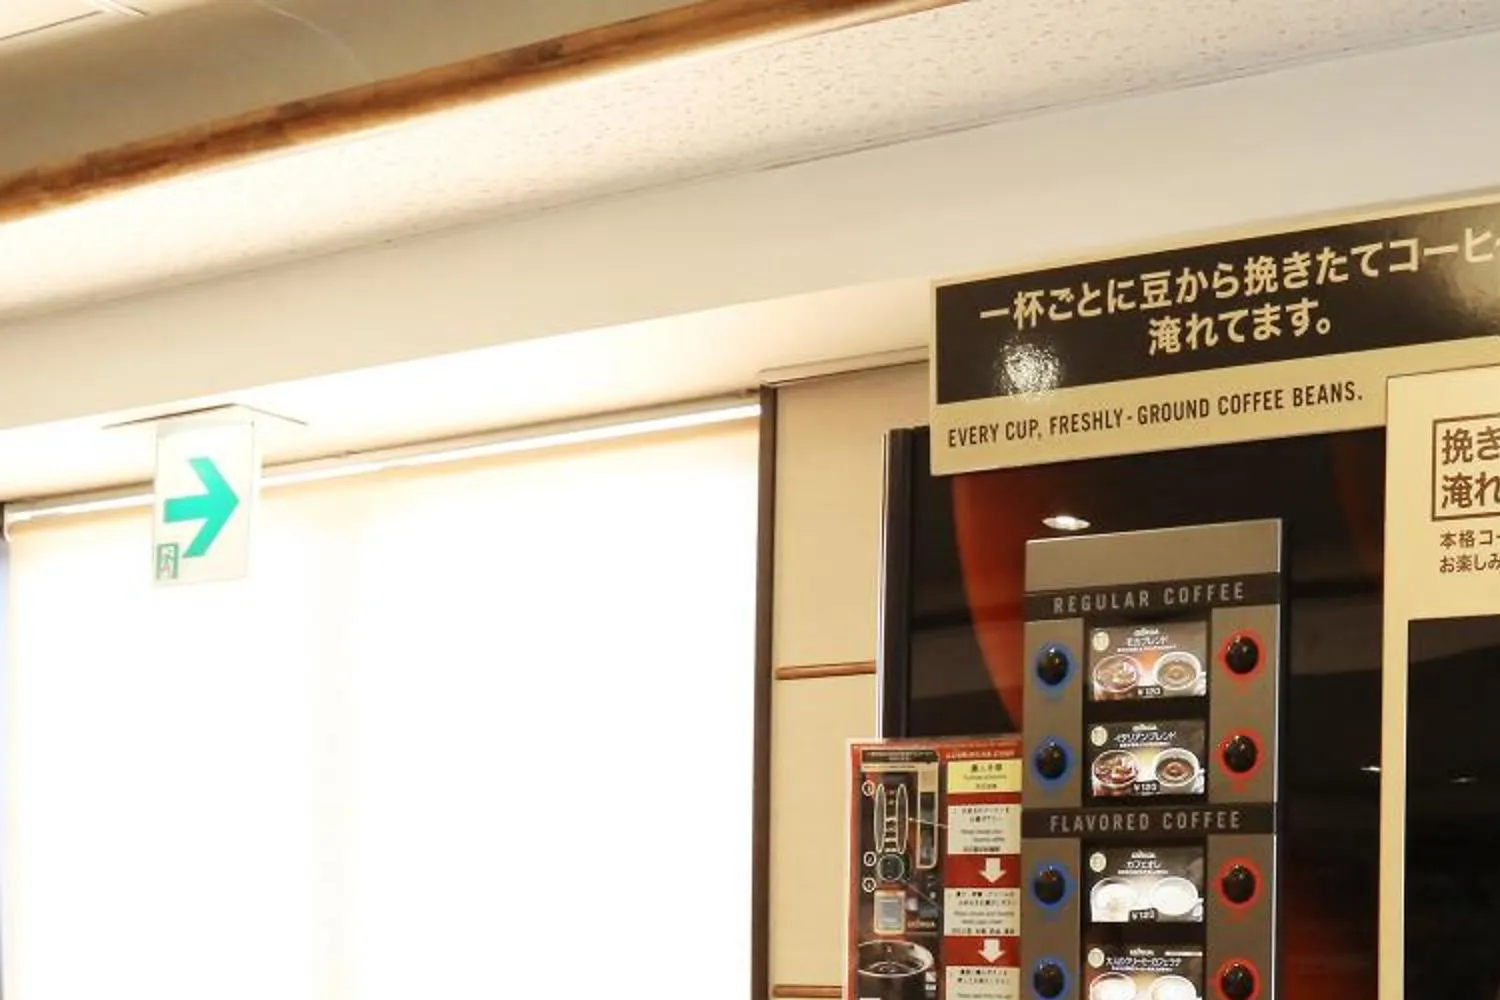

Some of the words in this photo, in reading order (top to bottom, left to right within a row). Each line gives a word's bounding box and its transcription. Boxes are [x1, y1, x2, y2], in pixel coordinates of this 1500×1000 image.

[1148, 298, 1333, 357] 淹れてます。
[948, 423, 1000, 448] EVERY
[1005, 419, 1042, 441] CUP,
[1217, 389, 1284, 415] COFFEE
[1292, 381, 1364, 407] BEANS.
[1053, 590, 1149, 614] REGULAR
[1163, 582, 1245, 605] COFFEE
[1050, 813, 1149, 832] FLAVORED
[1162, 811, 1241, 829] COFFEE
